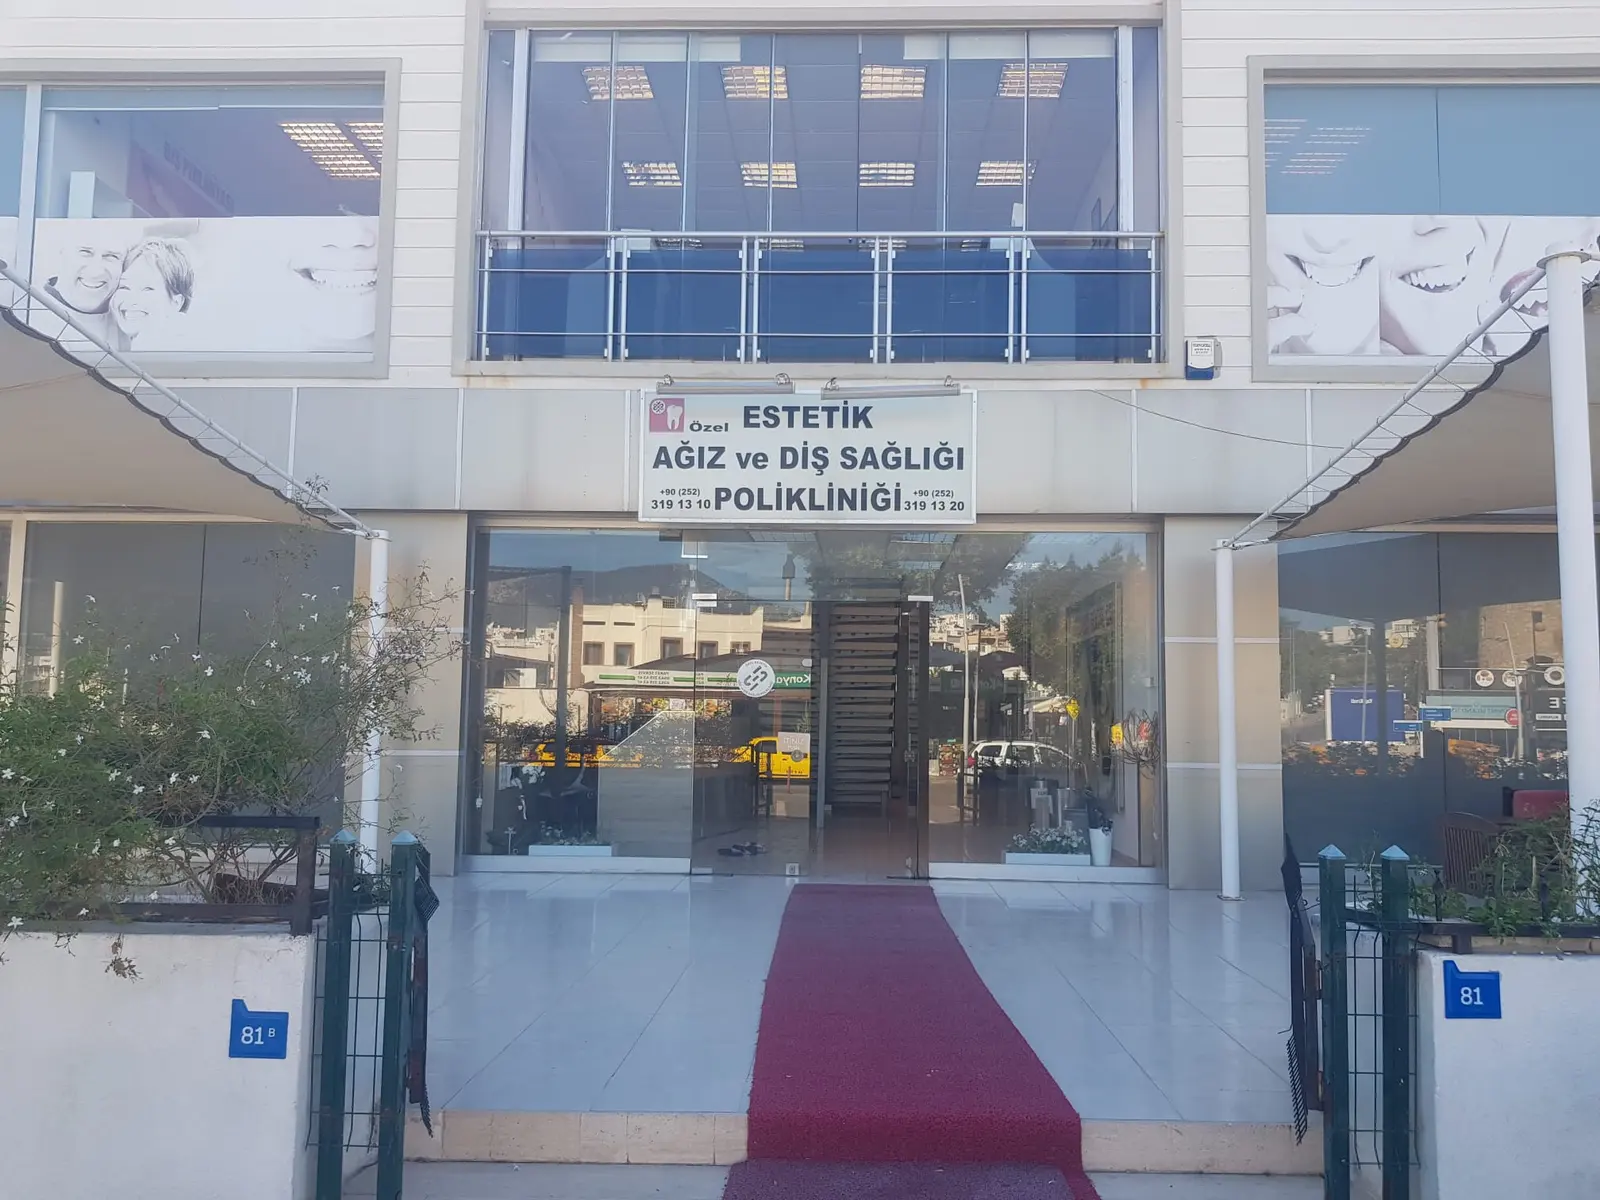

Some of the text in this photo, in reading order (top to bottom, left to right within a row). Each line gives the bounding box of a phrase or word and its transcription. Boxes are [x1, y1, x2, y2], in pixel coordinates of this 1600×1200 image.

[689, 400, 873, 432] Özel ESTETİK
[652, 440, 964, 476] AĞIZ ve DİŞ SAĞLIĞI
[660, 488, 701, 497] +90 (252)
[714, 482, 902, 511] POLİKLİNİĞİ
[913, 489, 954, 498] +90 (252)
[651, 499, 711, 509] 319 13 10
[904, 500, 965, 511] 319 13 20
[1460, 986, 1484, 1006] 81
[240, 1026, 276, 1045] 81 B
